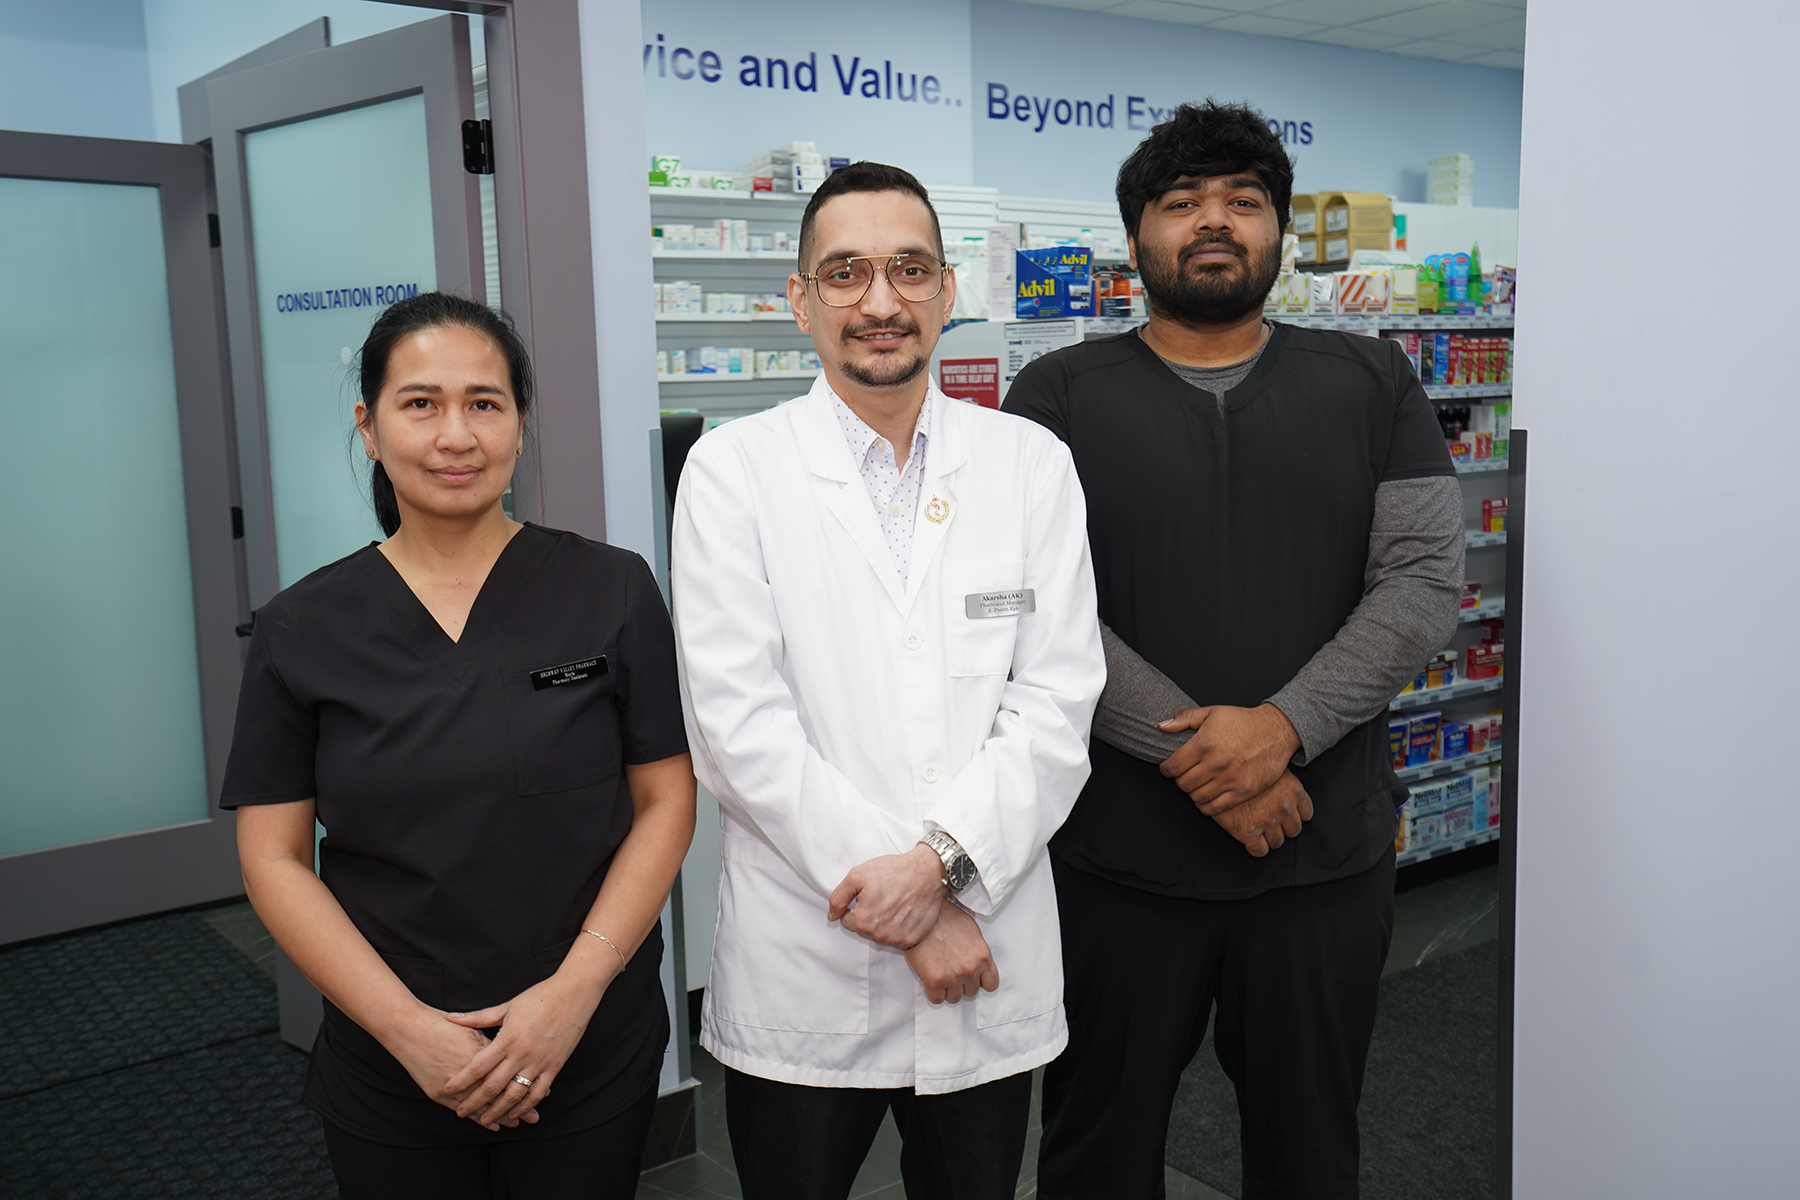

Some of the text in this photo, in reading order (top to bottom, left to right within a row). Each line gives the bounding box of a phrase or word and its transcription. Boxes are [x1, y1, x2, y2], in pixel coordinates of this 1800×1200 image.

[739, 52, 818, 92] and
[987, 82, 1115, 133] Beyond
[656, 158, 680, 174] G7
[1059, 253, 1088, 265] Advil
[1017, 278, 1056, 298] Advil
[276, 286, 371, 313] CONSULTATION
[942, 365, 968, 374] NARCOTICS
[979, 364, 997, 373] STORED
[983, 374, 995, 383] SAFE
[576, 660, 597, 669] PHARMACY
